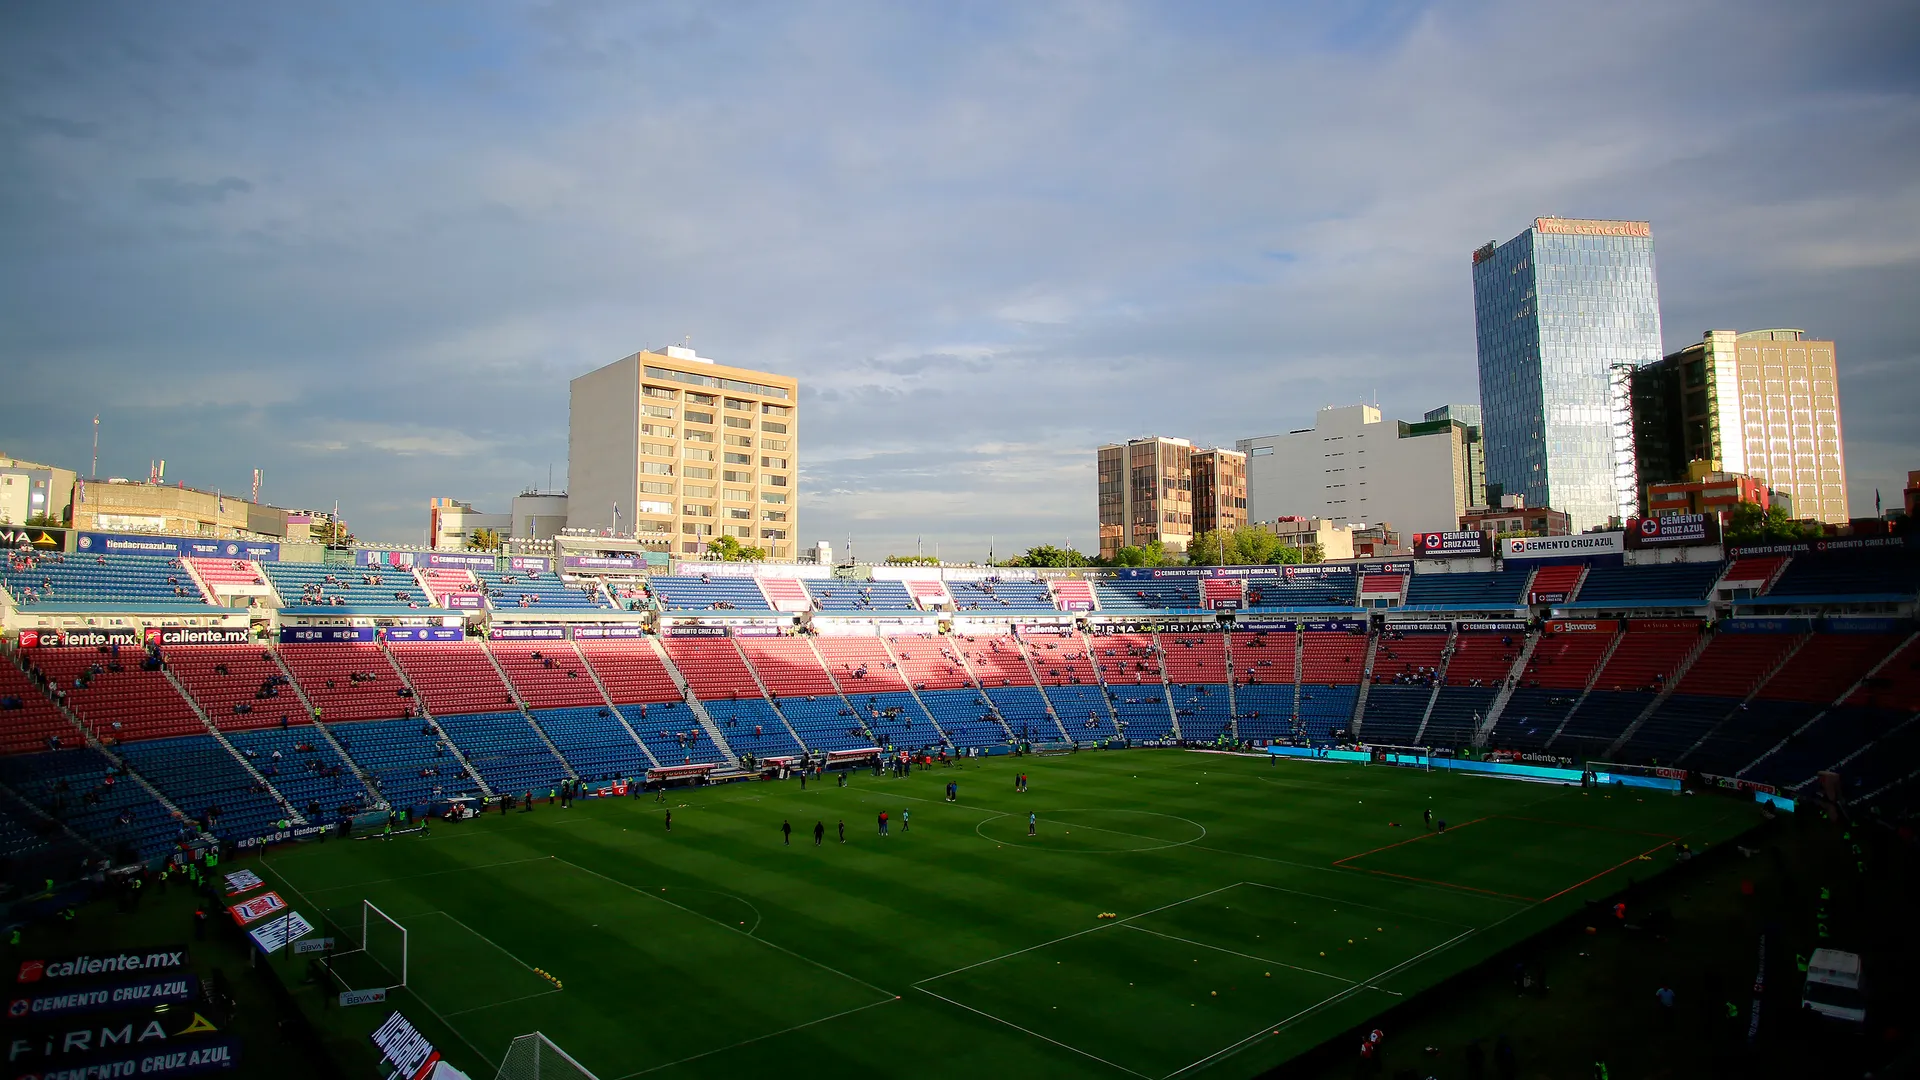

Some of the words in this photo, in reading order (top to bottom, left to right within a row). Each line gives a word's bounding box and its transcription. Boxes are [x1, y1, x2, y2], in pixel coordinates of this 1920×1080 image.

[1660, 513, 1704, 525] CEMENTO
[1661, 526, 1683, 535] CRUZ
[1683, 524, 1704, 533] AZUL
[1443, 532, 1480, 540] CEMENTO
[106, 539, 178, 551] tiendacruzazul.mx
[1443, 541, 1462, 549] CRUZ
[1462, 540, 1480, 548] AZUL
[1527, 541, 1569, 551] CEMENTO
[1571, 539, 1593, 549] CRUZ
[1594, 538, 1613, 547] AZUL
[1827, 540, 1863, 549] CEMENTO
[1864, 539, 1884, 547] CRUZ
[1885, 537, 1904, 546] AZUL
[1739, 546, 1772, 555] CEMENTO
[1773, 545, 1791, 553] CRUZ
[1792, 543, 1810, 552] AZUL
[1337, 565, 1351, 573] AZUL
[503, 629, 531, 637] CEMENTO
[1026, 625, 1072, 633] caliente.mx
[1094, 624, 1135, 632] PIRMA
[1159, 624, 1199, 632] PIRMA
[40, 632, 134, 645] caiente.mx
[163, 630, 248, 643] caliente.mx
[300, 944, 322, 952] BBVA
[45, 951, 183, 978] caliente.mx
[32, 990, 109, 1013] CEMENTO
[112, 985, 150, 1001] CRUZ
[152, 980, 189, 997] AZUL
[347, 995, 371, 1004] BBVA
[140, 1052, 187, 1073] CRUZ
[188, 1045, 231, 1066] AZUL
